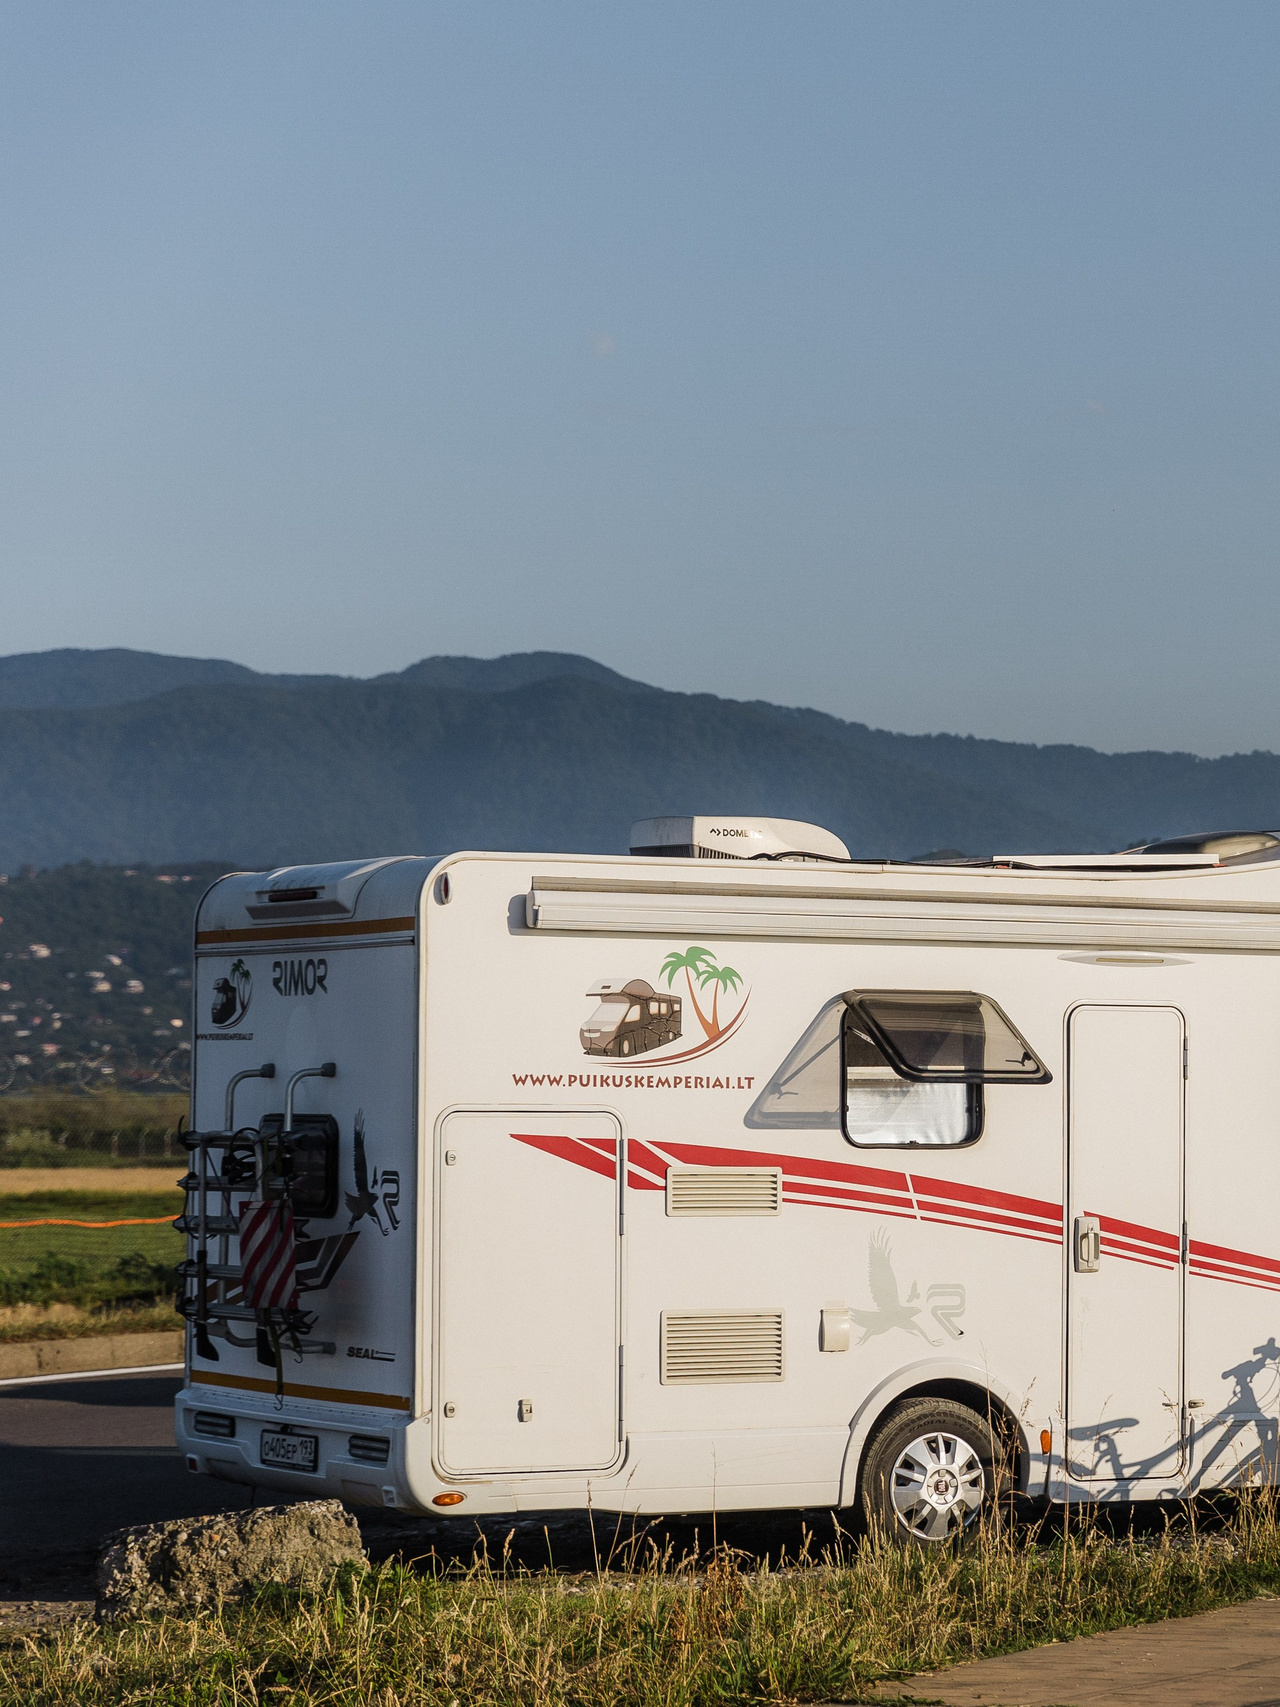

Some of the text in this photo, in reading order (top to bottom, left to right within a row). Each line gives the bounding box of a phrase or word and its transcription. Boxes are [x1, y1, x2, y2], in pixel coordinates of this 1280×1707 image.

[722, 828, 763, 839] DOME
[272, 958, 328, 997] RIMOR
[512, 1073, 755, 1090] WWW.PUIKUSKEMPERIAI.LT
